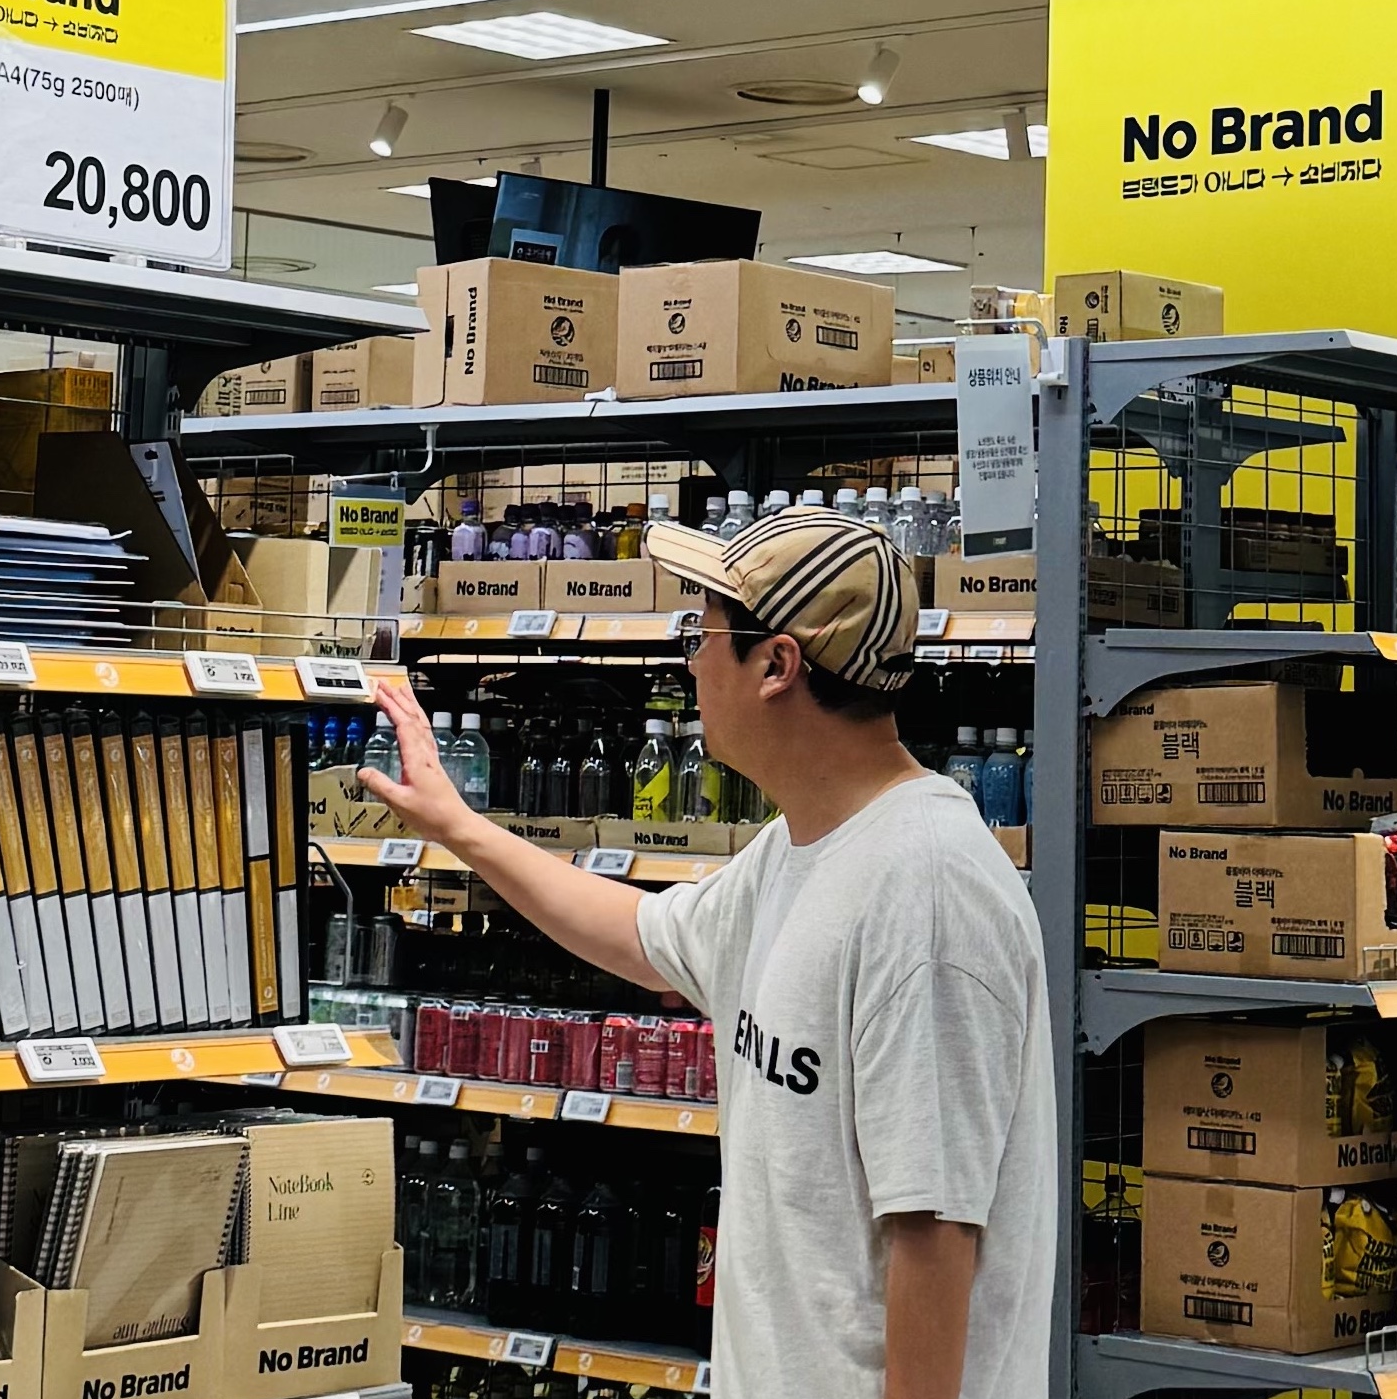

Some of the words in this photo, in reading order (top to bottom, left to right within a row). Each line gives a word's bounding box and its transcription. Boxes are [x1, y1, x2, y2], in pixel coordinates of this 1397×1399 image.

[1122, 114, 1197, 164] No
[1210, 89, 1383, 157] Brand
[43, 150, 212, 231] 20,800
[1122, 172, 1199, 199] 브랜드가
[1204, 167, 1267, 194] 아니다
[1300, 158, 1382, 186] 소비자다
[967, 367, 1003, 387] 상품위치
[679, 579, 702, 595] No
[960, 575, 984, 594] No
[1161, 732, 1200, 761] 블랙
[1168, 845, 1187, 861] No
[1189, 846, 1228, 861] Brand
[1233, 879, 1276, 909] 블랙
[267, 1172, 335, 1197] NoteBook
[267, 1202, 300, 1223] Line
[259, 1348, 293, 1374] No
[297, 1338, 369, 1371] Brand
[119, 1364, 191, 1399] Brand
